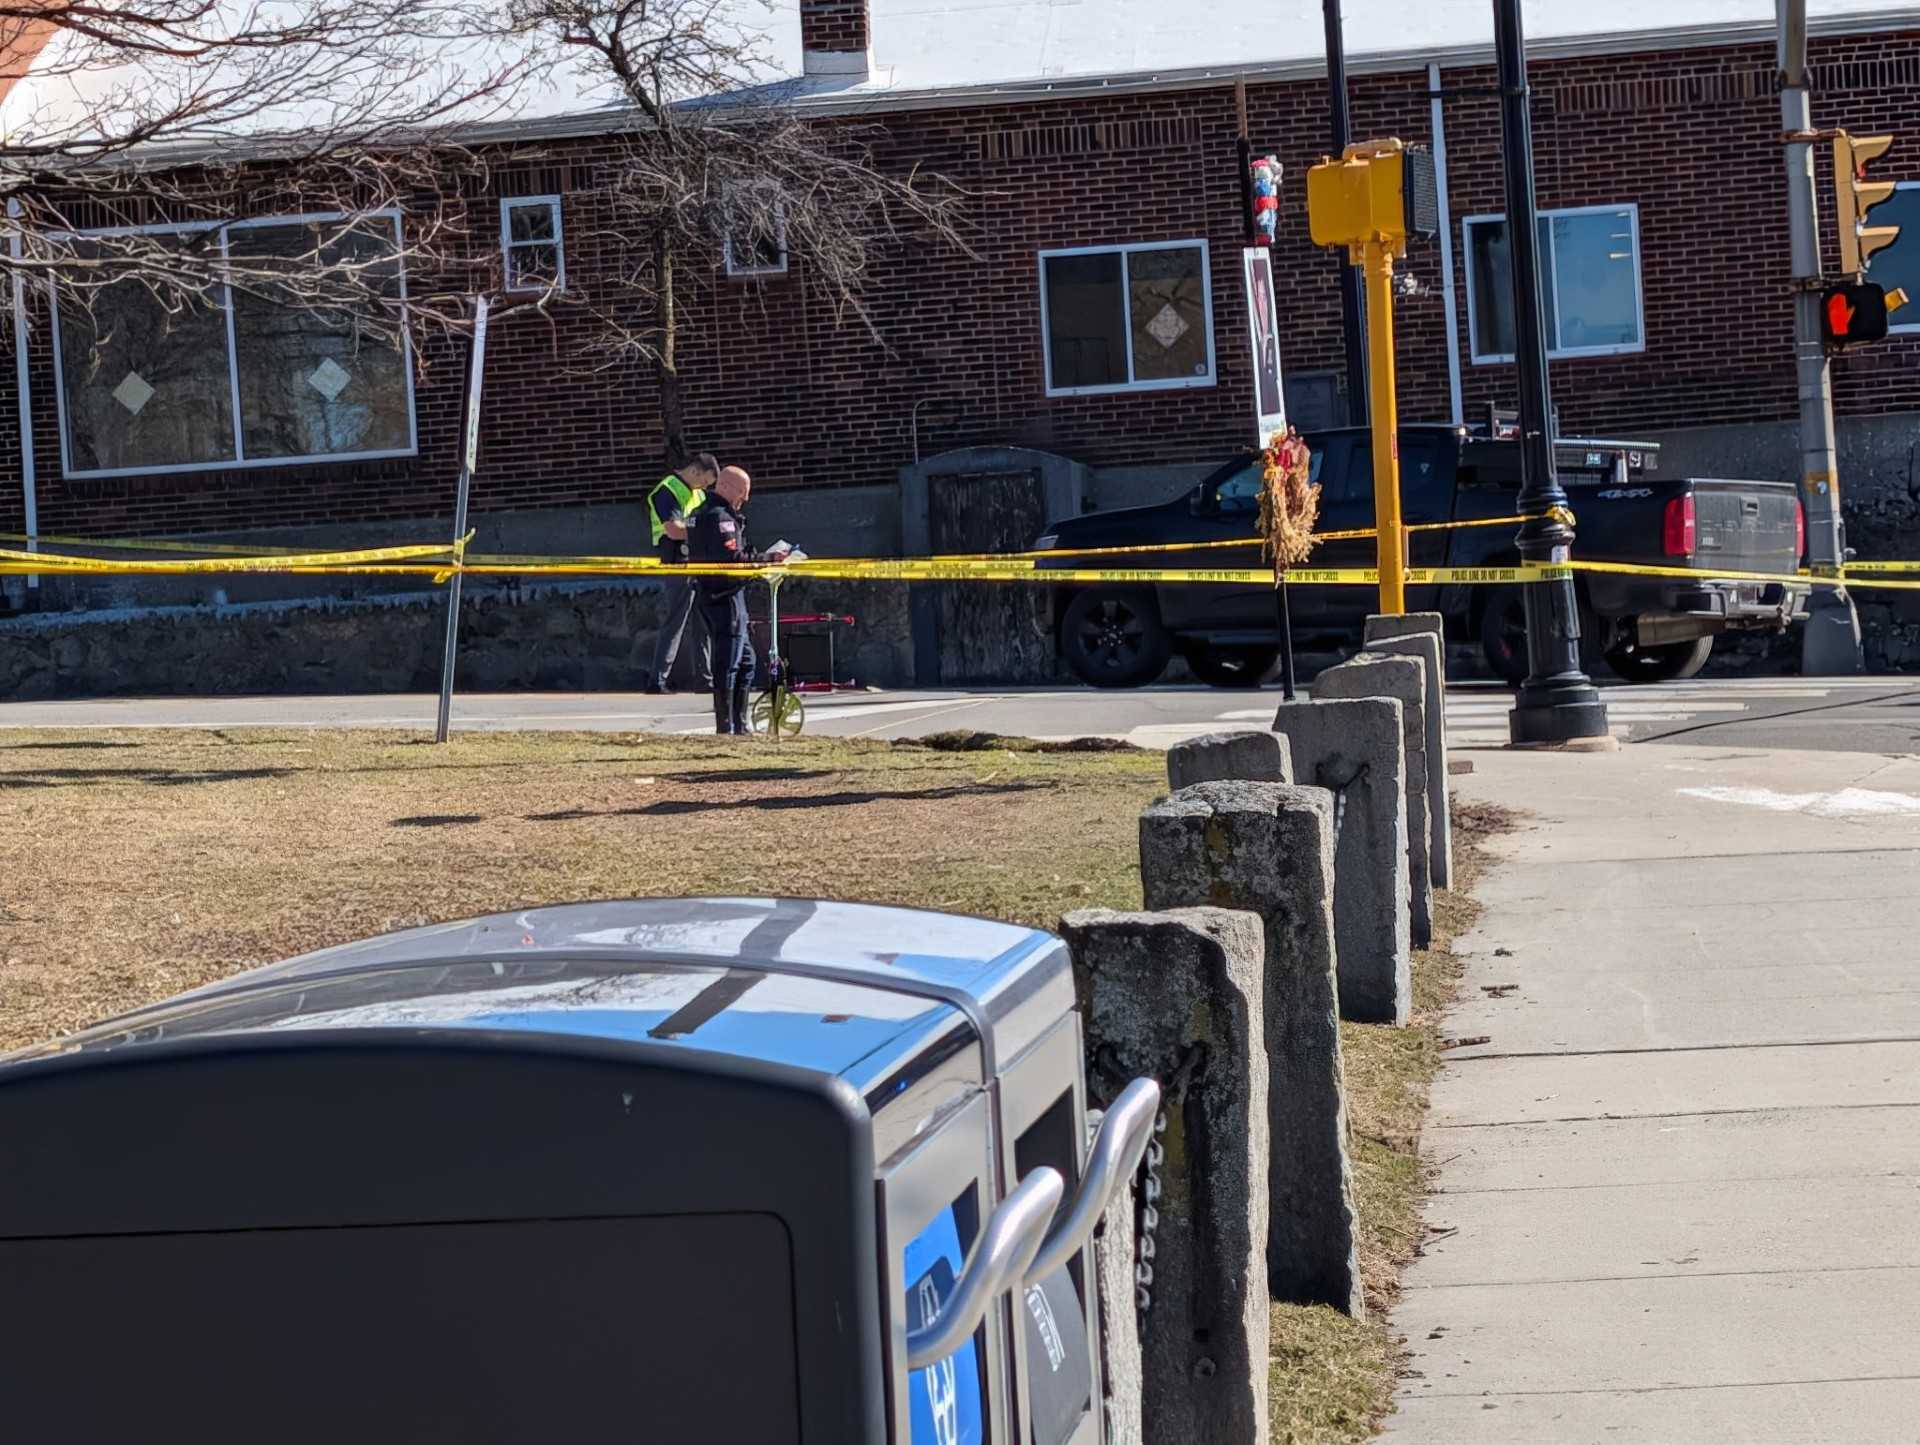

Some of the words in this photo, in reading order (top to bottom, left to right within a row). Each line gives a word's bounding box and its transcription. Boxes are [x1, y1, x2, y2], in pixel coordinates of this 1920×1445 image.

[1363, 571, 1379, 582] POLIC
[1451, 569, 1468, 581] POLICE
[1469, 569, 1480, 581] LINE
[1488, 569, 1498, 580] NOT
[1499, 569, 1516, 580] CROSS
